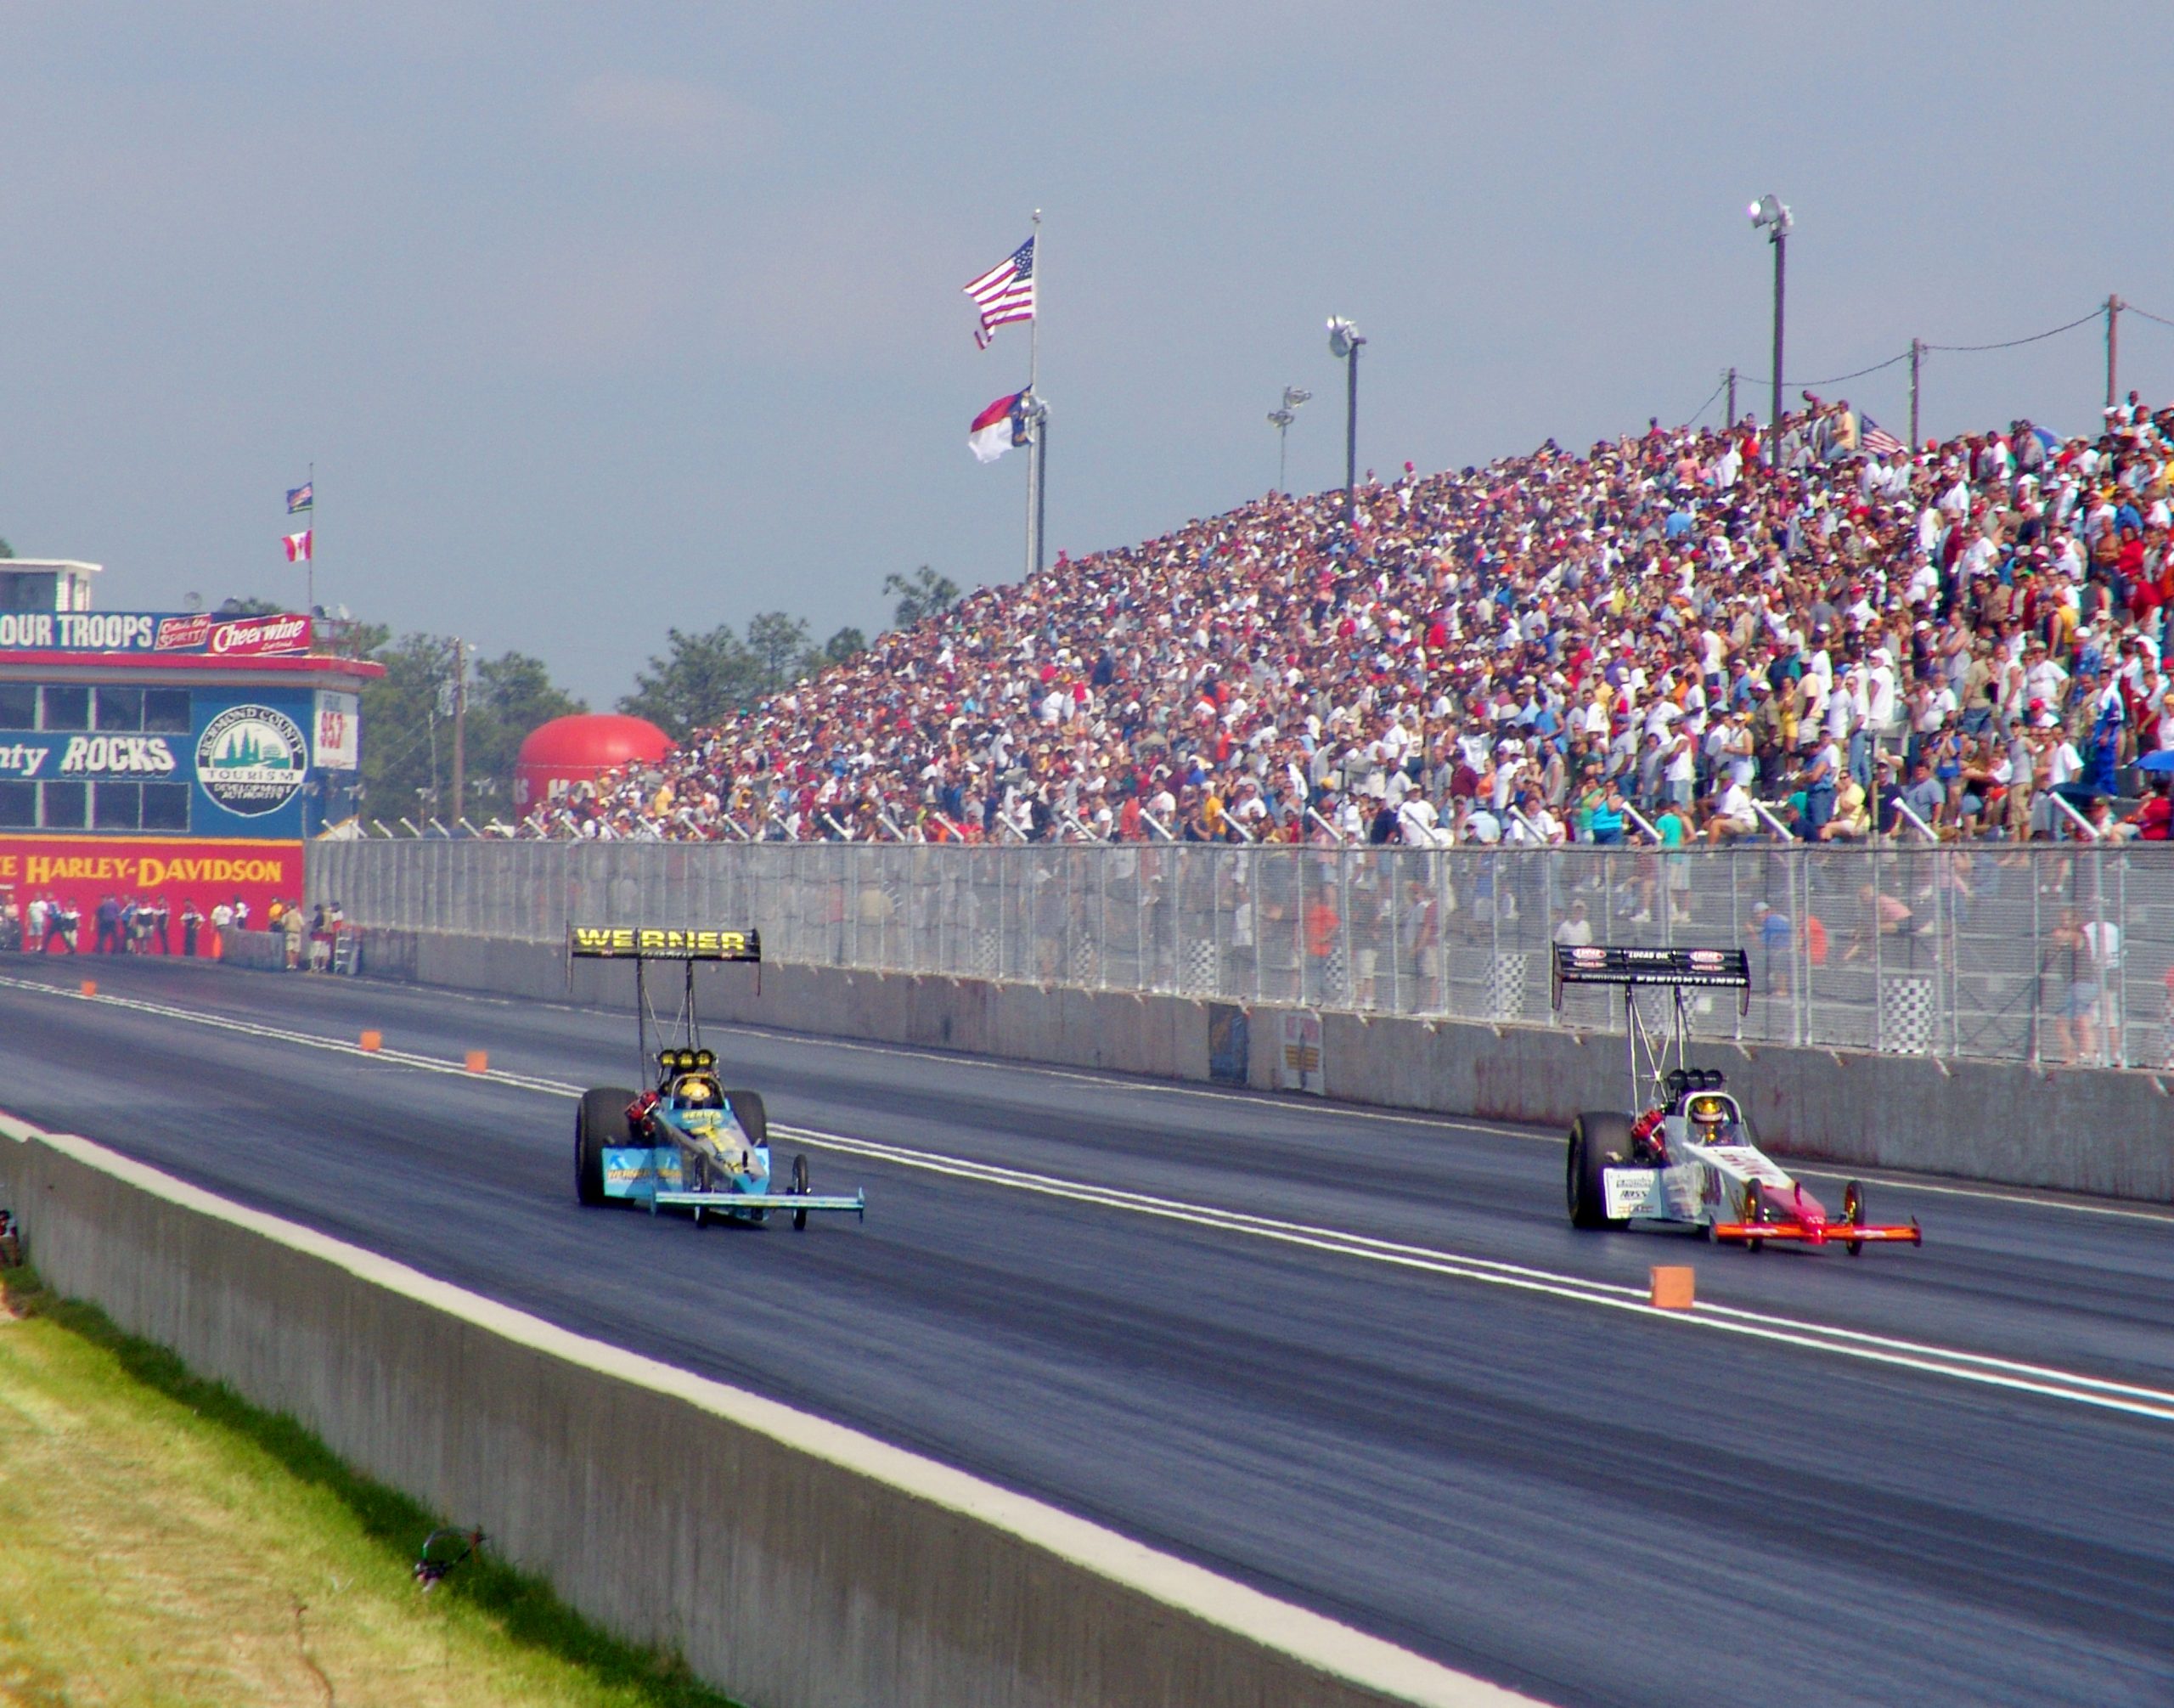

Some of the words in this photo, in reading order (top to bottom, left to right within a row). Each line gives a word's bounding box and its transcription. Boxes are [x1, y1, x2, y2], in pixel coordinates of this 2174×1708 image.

[0, 614, 53, 646] OUR
[57, 614, 154, 648] TROOPS
[213, 618, 305, 653] Cheerwine
[201, 707, 257, 757] RICHMOND
[260, 708, 303, 754] COUNTY
[59, 736, 175, 776] ROCKS
[207, 770, 295, 781] TOURISM
[214, 784, 292, 794] DEVELOPMENT
[25, 856, 282, 887] HARLEY-DAVIDSON
[577, 927, 745, 950] WERNER
[1629, 950, 1653, 959] LUCAS
